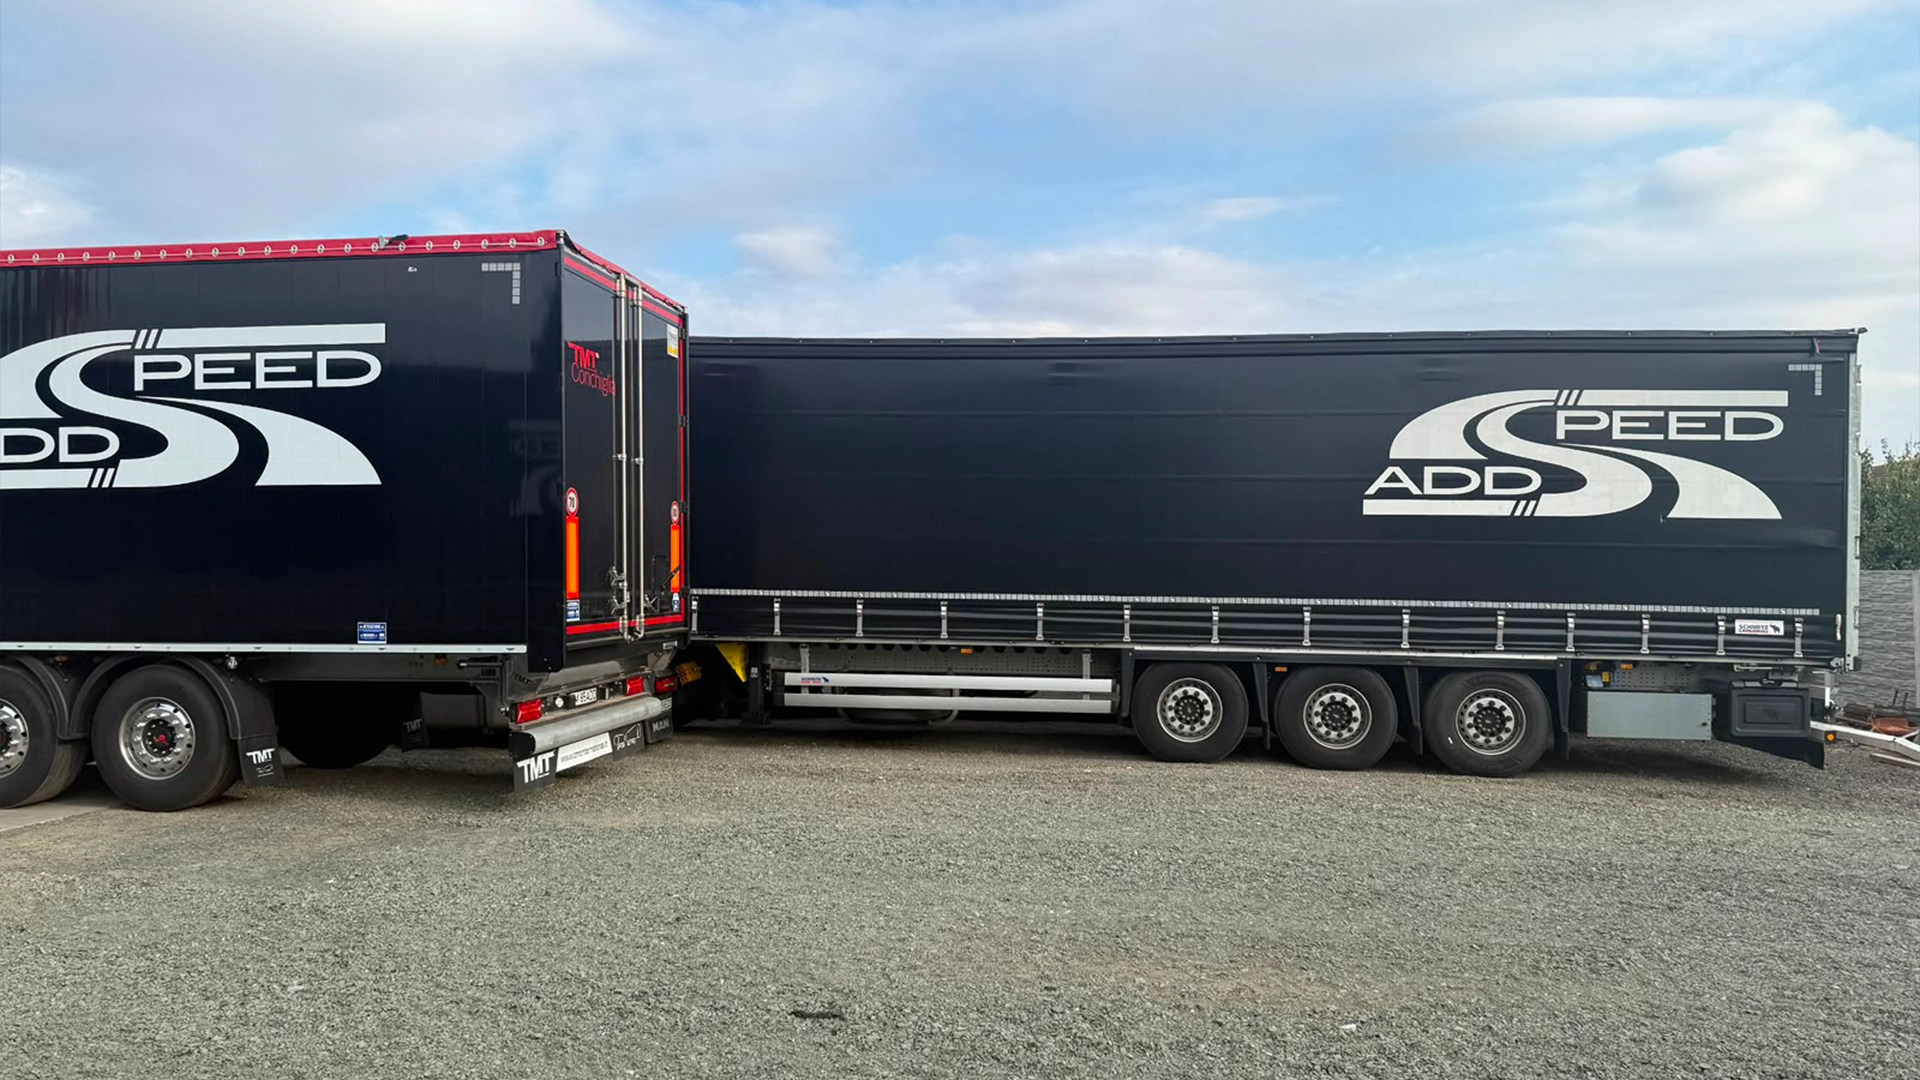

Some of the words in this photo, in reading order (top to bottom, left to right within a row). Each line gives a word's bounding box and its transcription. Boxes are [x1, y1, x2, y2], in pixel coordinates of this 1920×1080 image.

[567, 341, 600, 369] TMT
[1364, 465, 1543, 496] ADD
[246, 748, 275, 764] TMT
[516, 750, 555, 783] TMT
